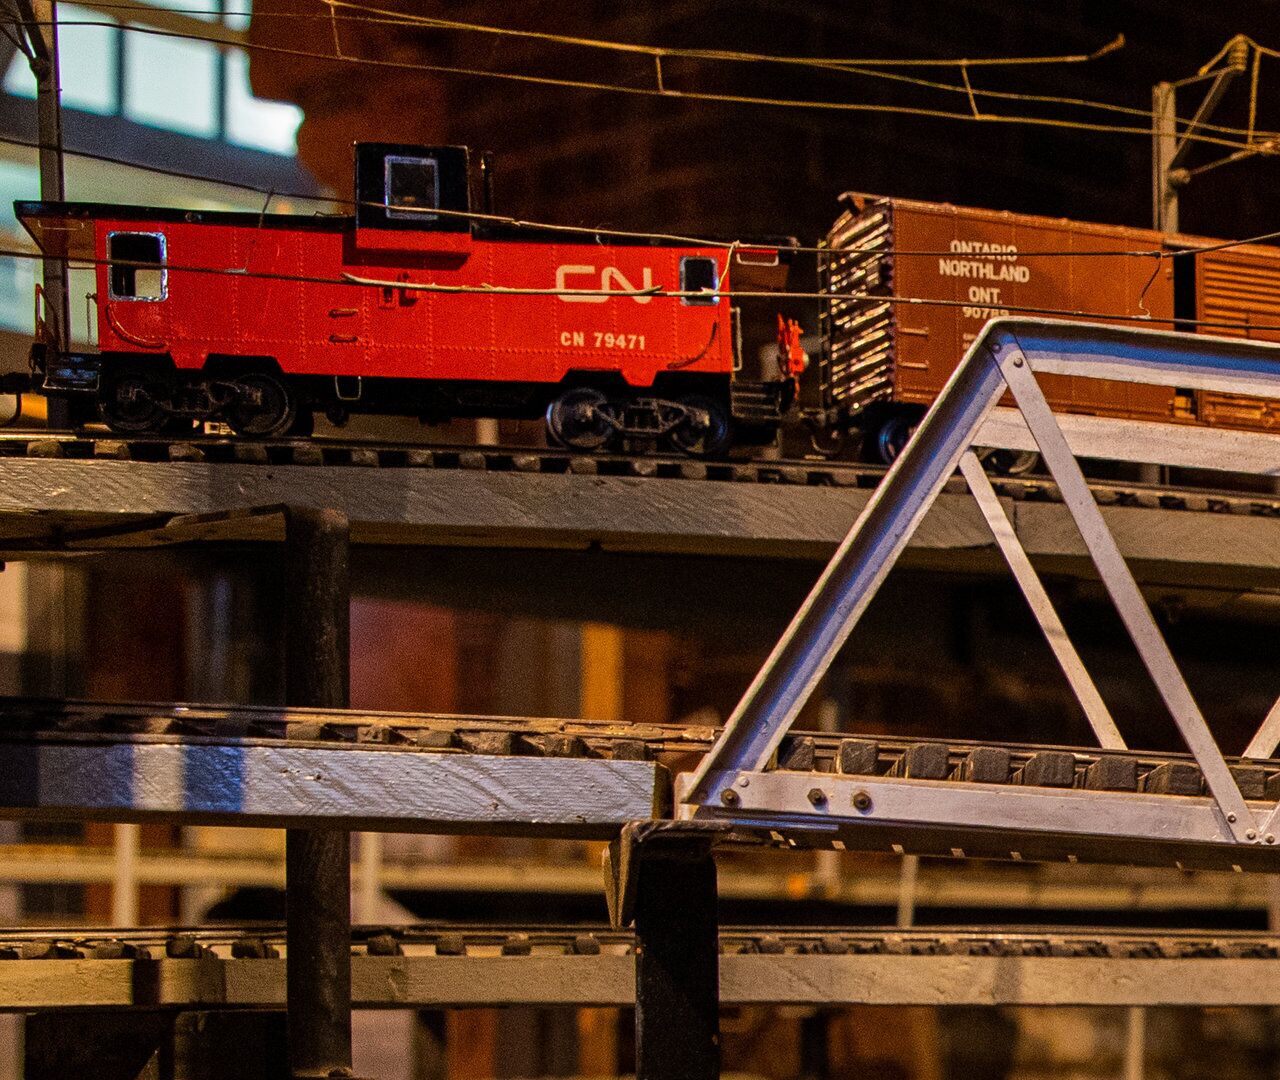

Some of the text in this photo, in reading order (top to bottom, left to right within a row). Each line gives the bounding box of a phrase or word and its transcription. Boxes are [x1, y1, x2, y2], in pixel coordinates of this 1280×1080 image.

[950, 239, 1017, 262] ONTARIO
[939, 258, 1030, 283] NORTHLAND
[555, 264, 652, 304] CN
[968, 286, 1003, 304] ONT.
[560, 331, 645, 350] CN 79471
